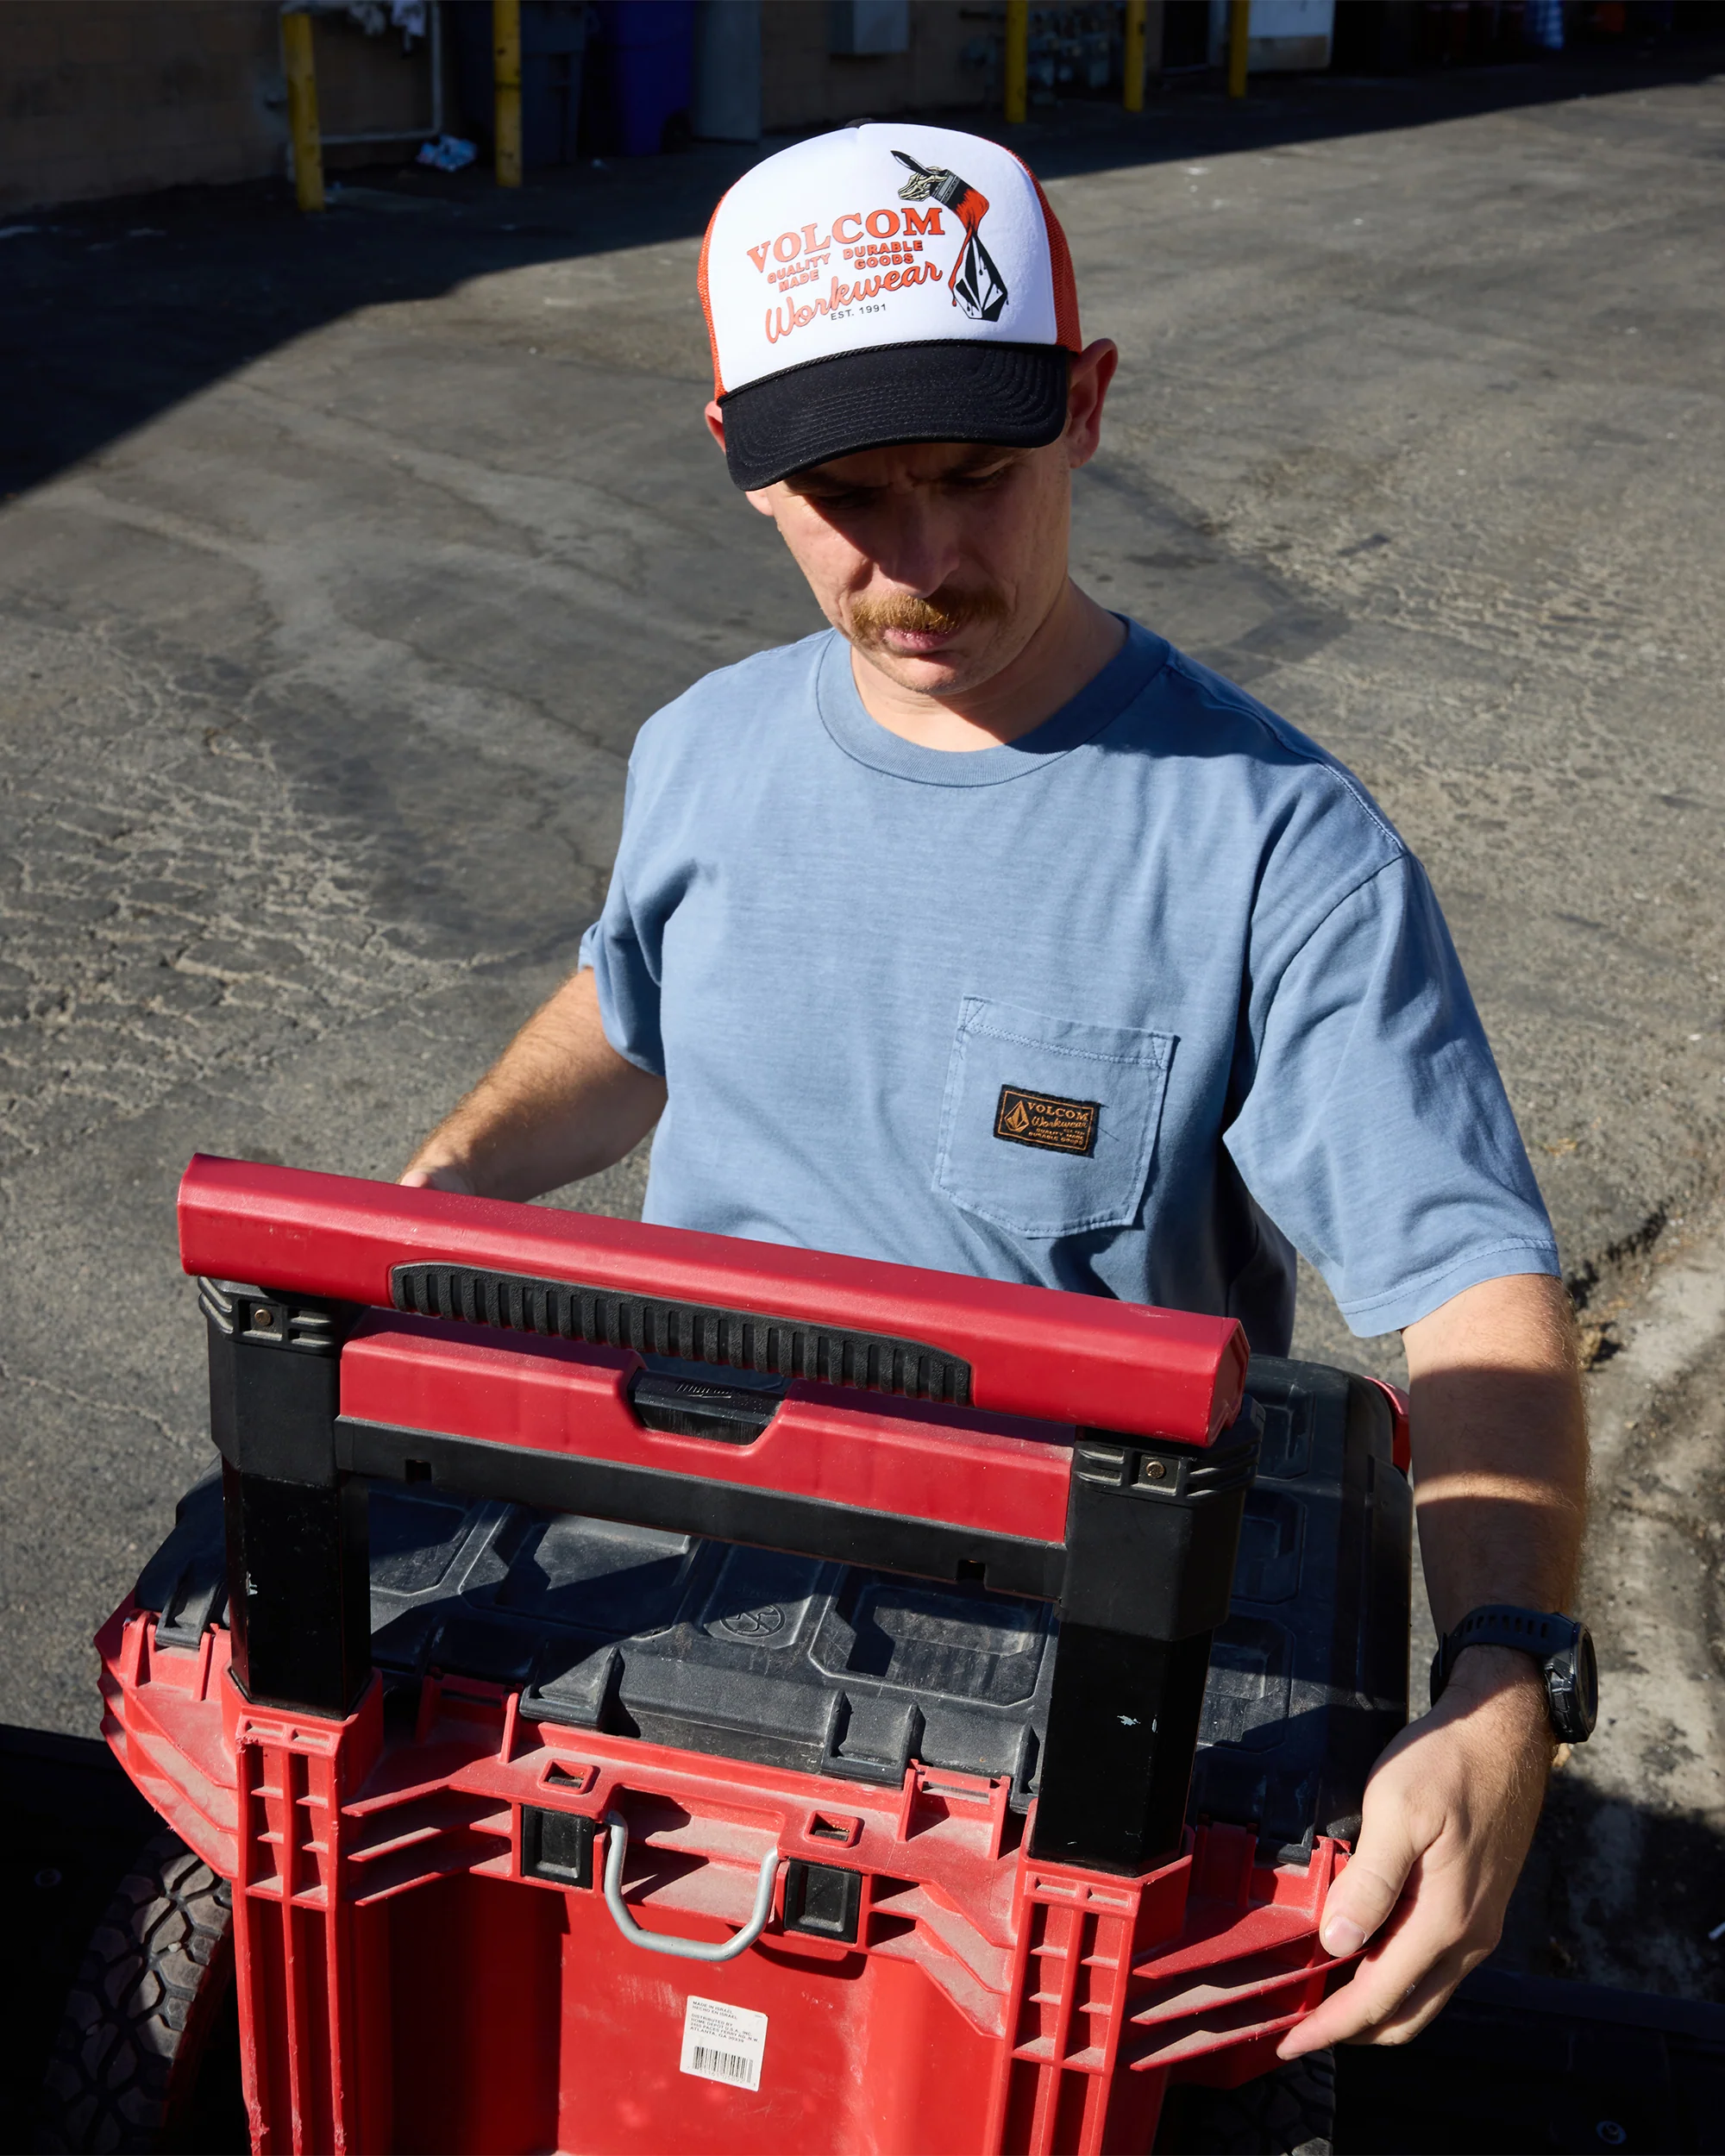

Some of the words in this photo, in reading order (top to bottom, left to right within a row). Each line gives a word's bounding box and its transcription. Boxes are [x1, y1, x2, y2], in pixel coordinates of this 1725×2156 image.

[747, 208, 945, 273] VOLCOM
[843, 241, 923, 260] DURABLE
[767, 253, 831, 284] QUALITY
[855, 254, 913, 270] GOODS
[779, 269, 819, 292] MADE
[765, 261, 943, 343] Workwear
[831, 310, 855, 321] EST.
[859, 304, 887, 315] 1991
[1027, 1102, 1088, 1121] VOLCOM
[1032, 1116, 1088, 1128] Workwear
